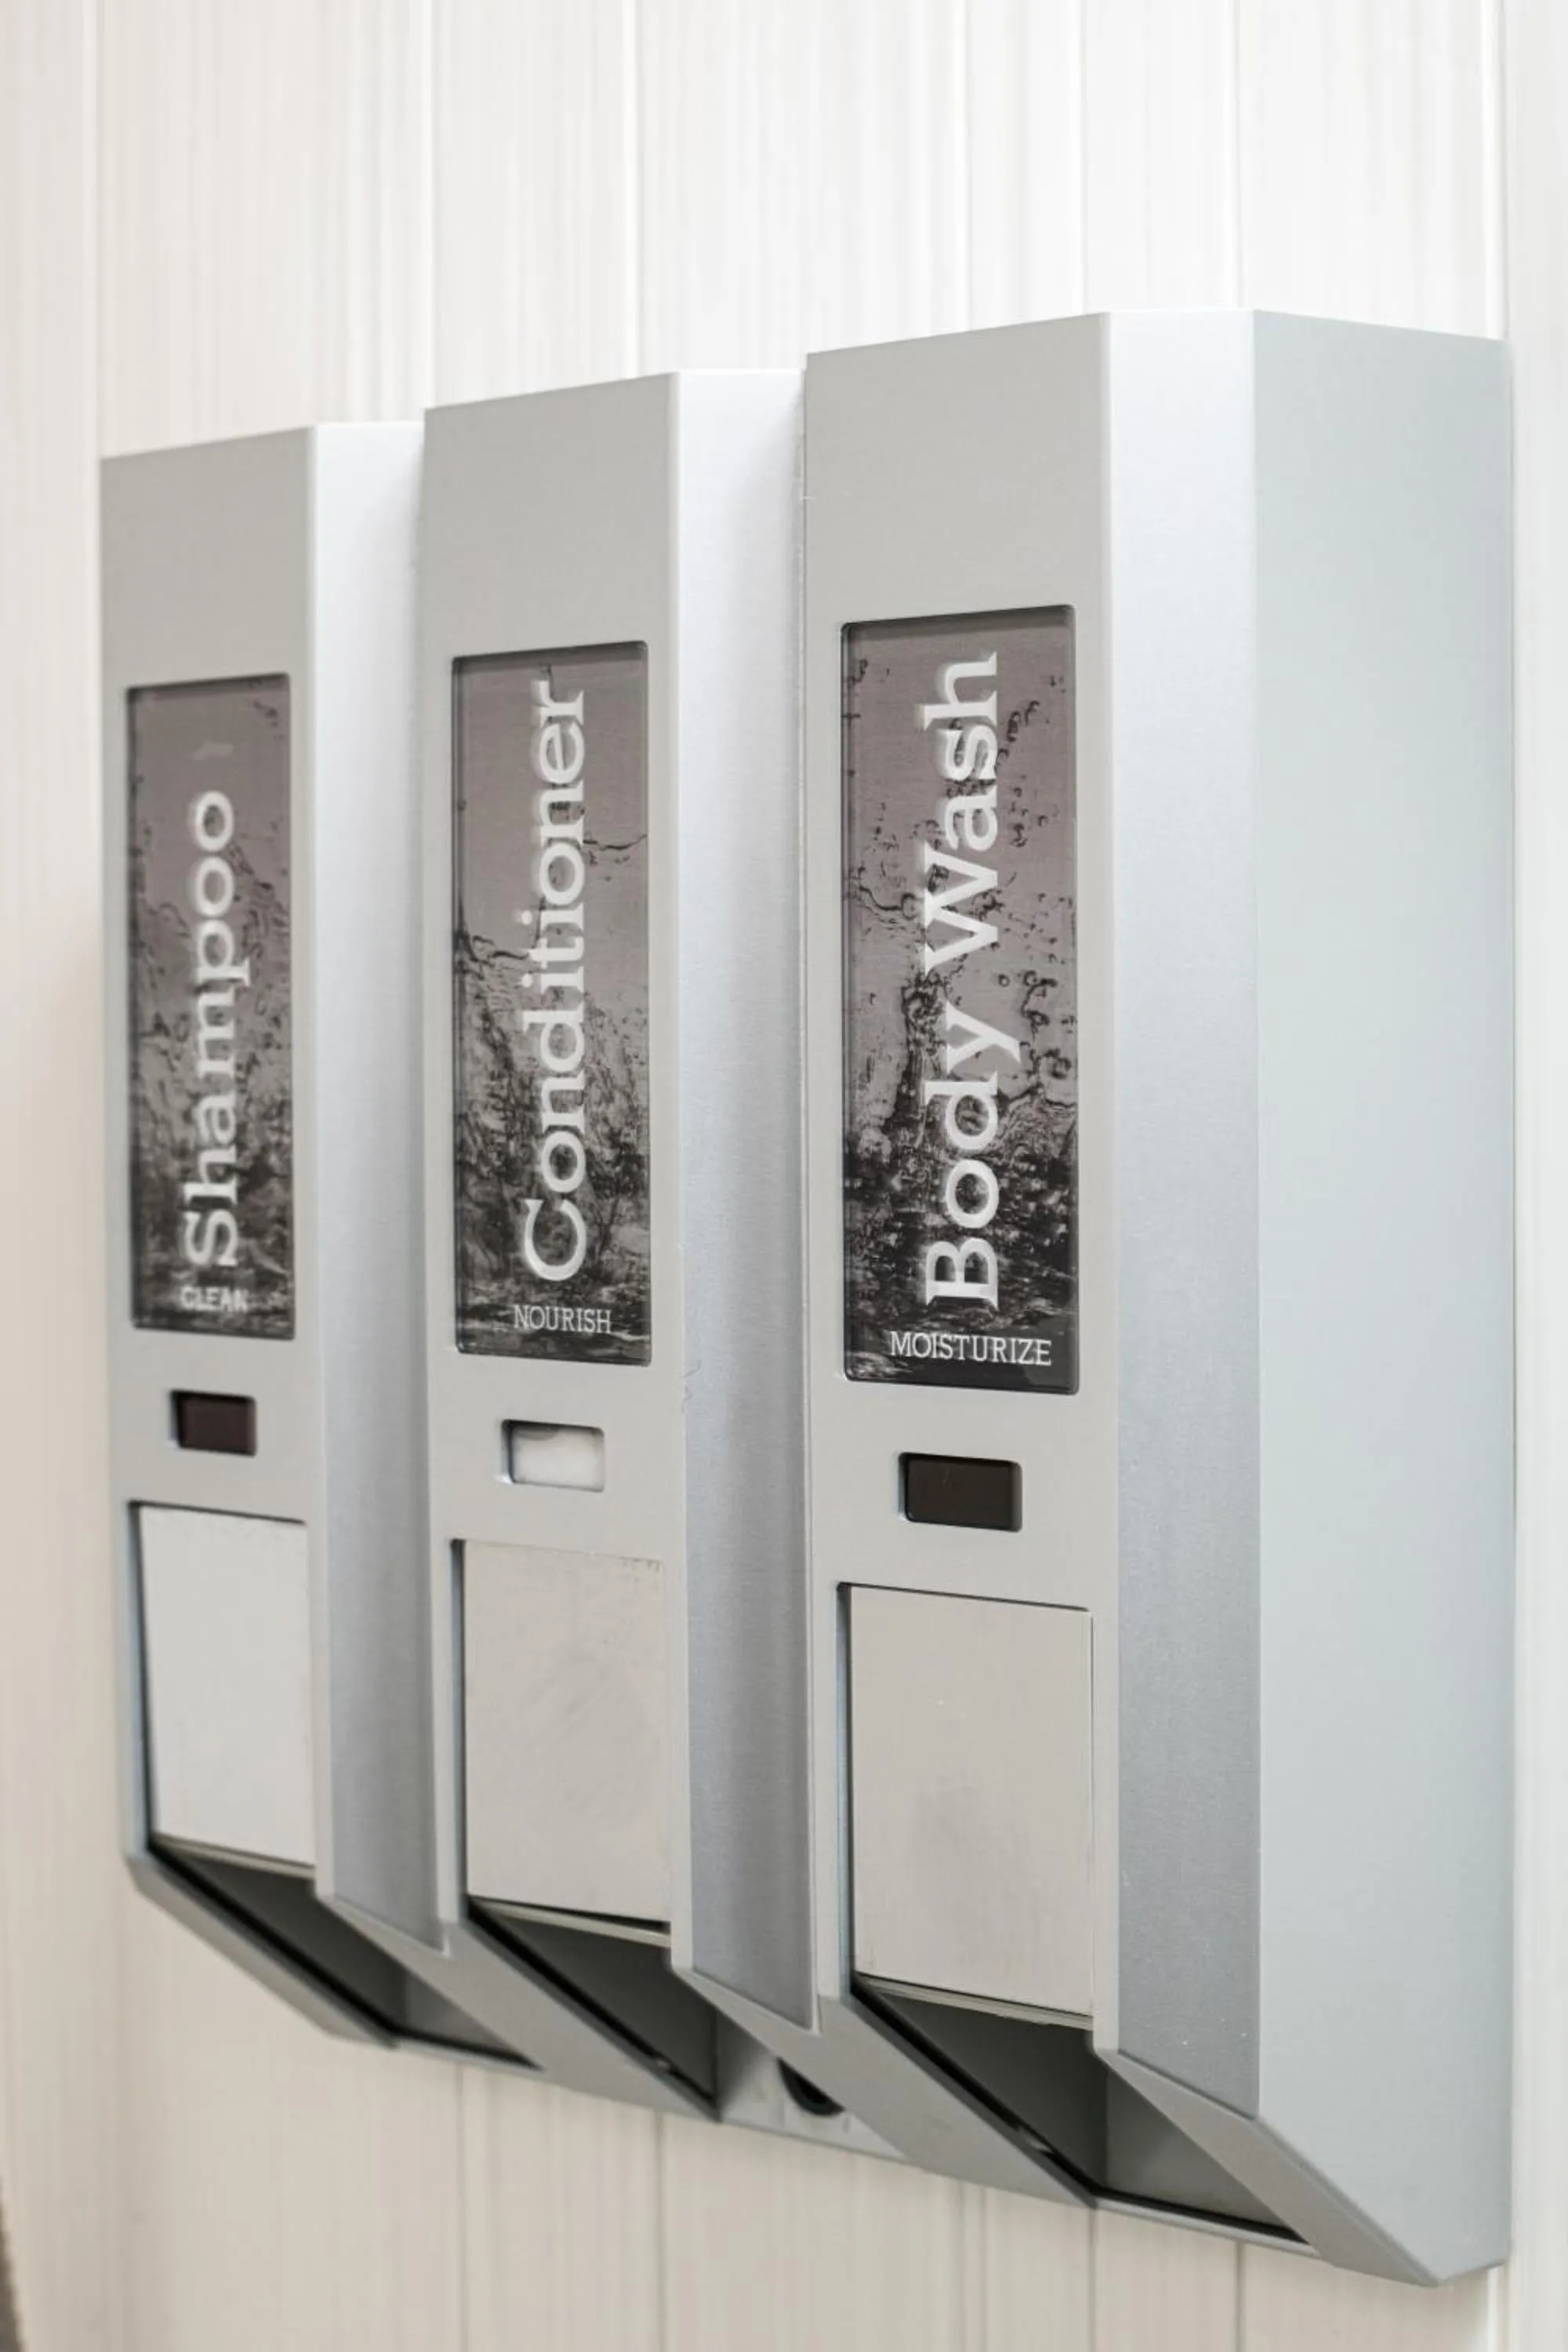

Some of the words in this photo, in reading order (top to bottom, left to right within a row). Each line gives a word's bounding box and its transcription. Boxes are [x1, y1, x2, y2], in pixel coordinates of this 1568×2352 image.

[924, 651, 999, 973] Wash
[183, 791, 250, 1266] Shampoo
[518, 680, 586, 1282] Conditioner
[180, 1284, 249, 1313] CLEAN
[924, 1003, 1021, 1308] Body
[514, 1303, 612, 1334] NOURISH
[888, 1330, 1053, 1367] MOISTURIZE
